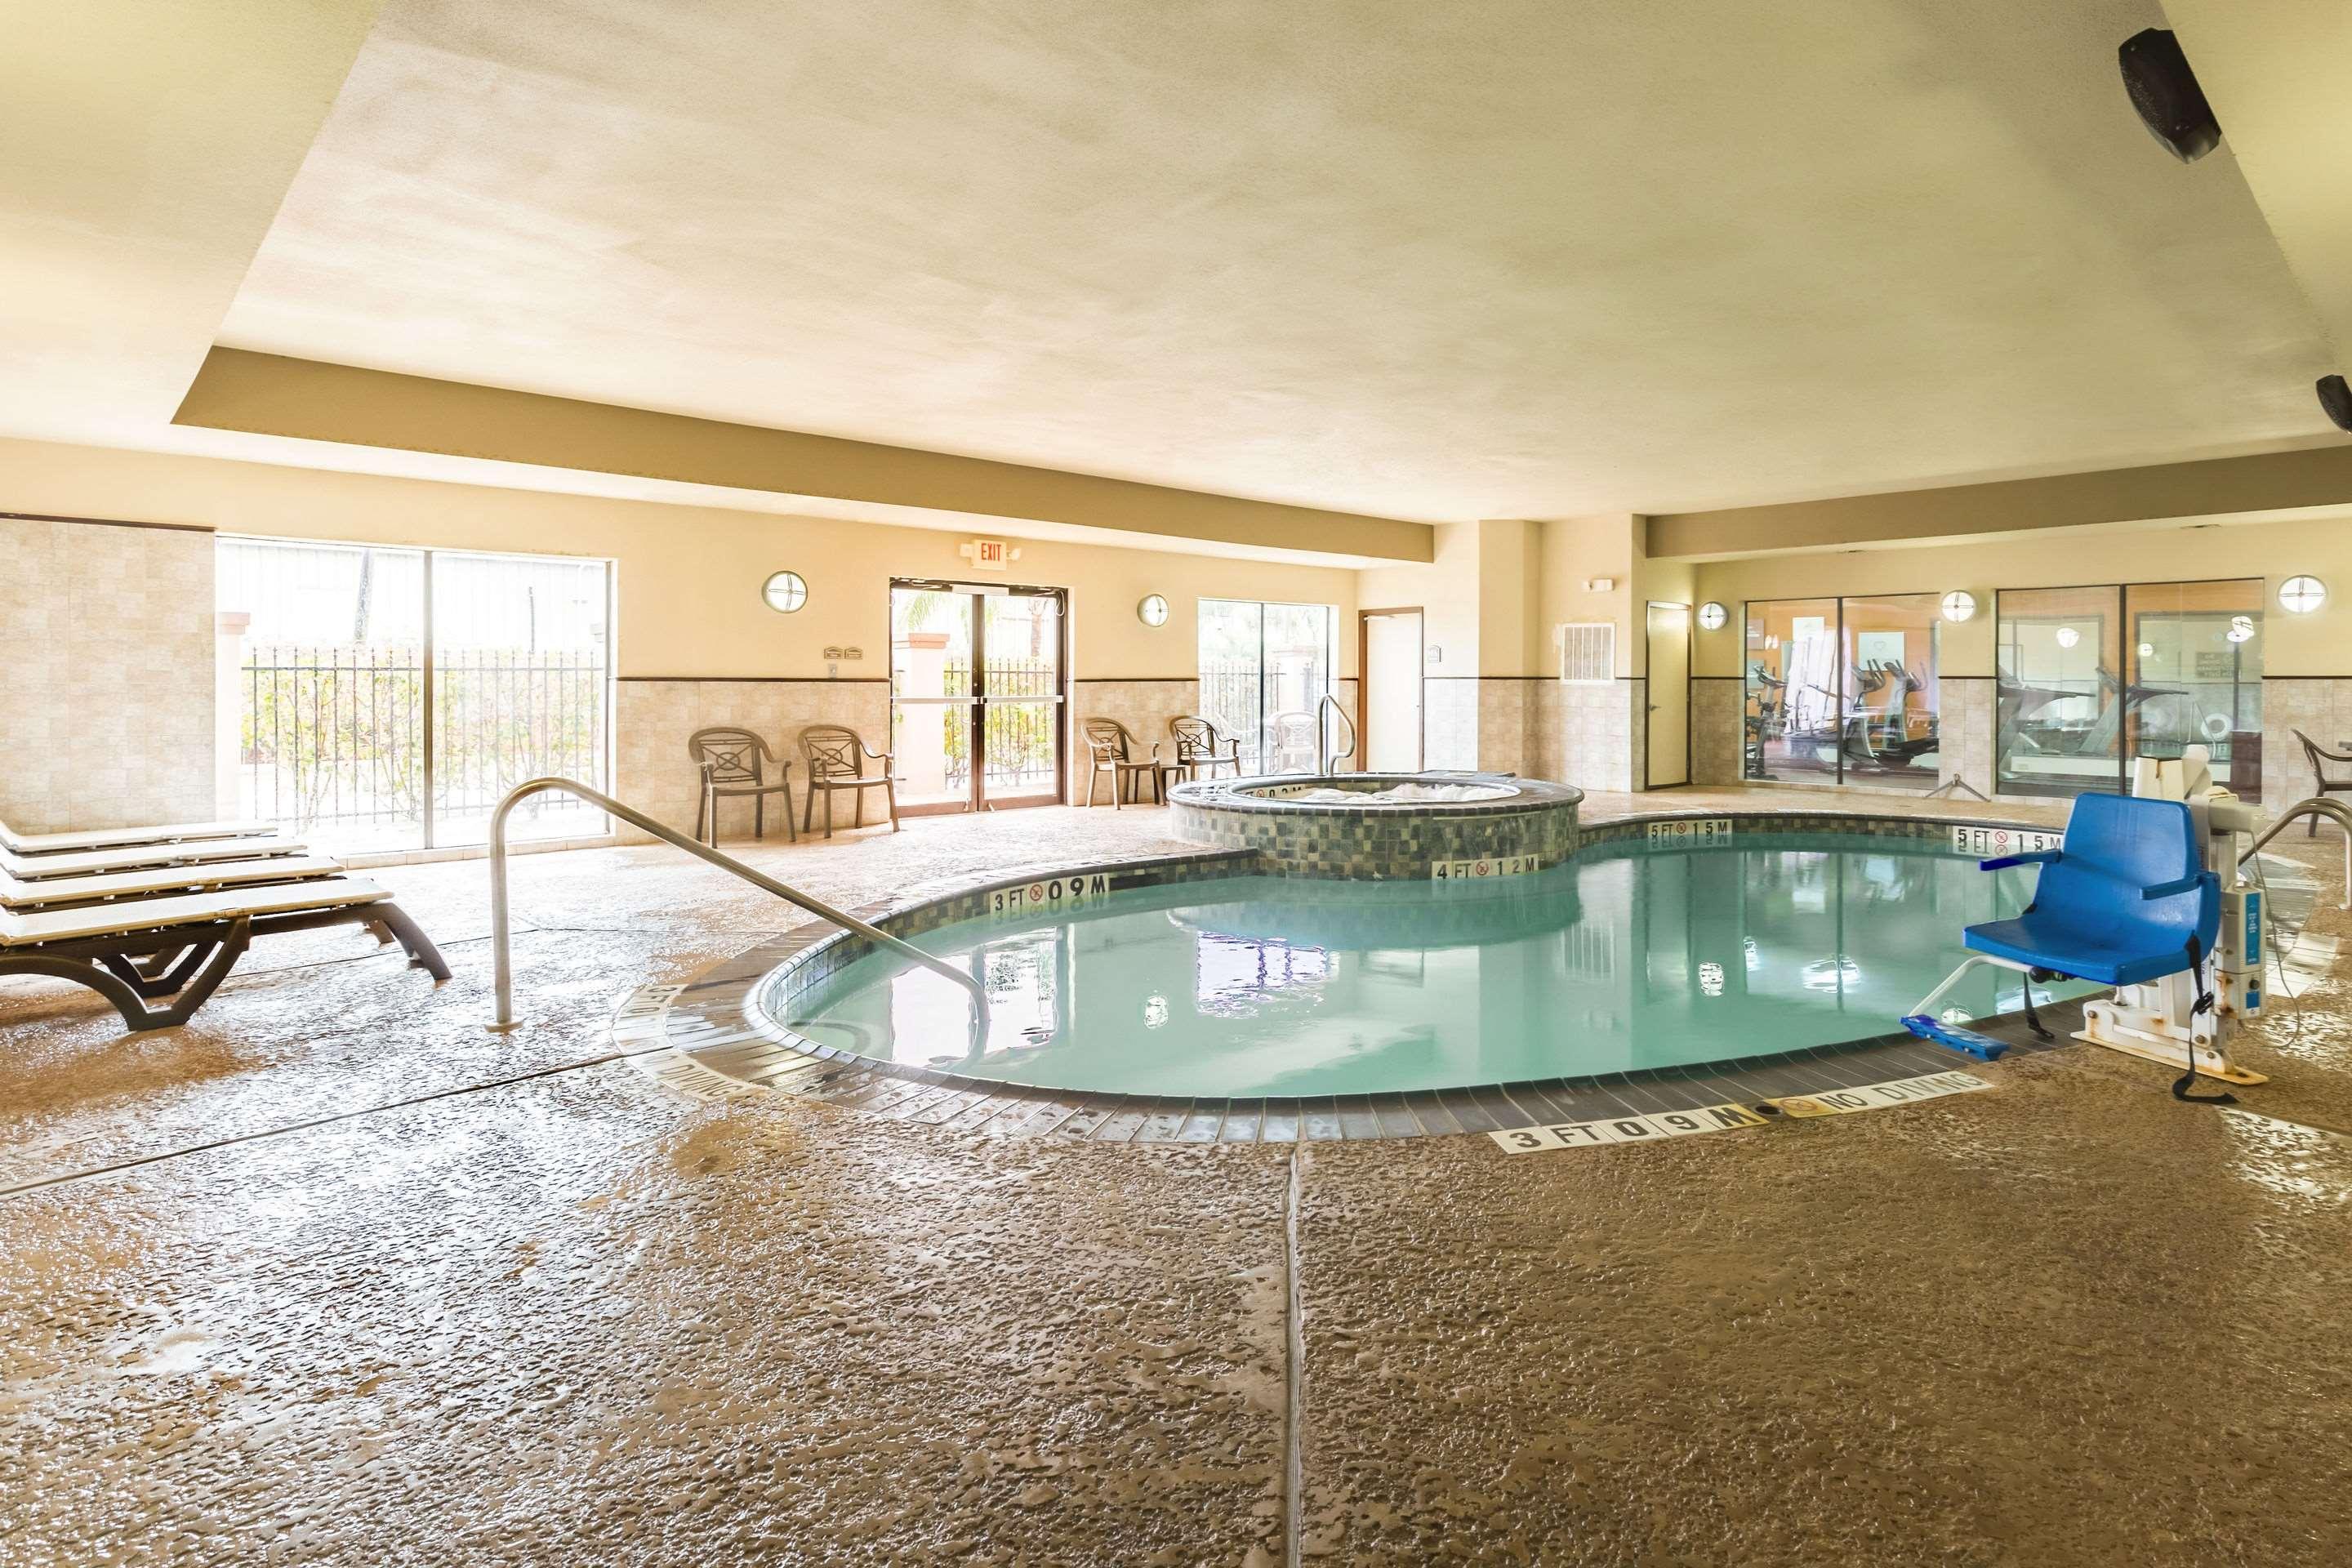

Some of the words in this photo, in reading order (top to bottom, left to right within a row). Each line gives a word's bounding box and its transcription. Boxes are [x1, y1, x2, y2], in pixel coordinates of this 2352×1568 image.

[981, 542, 1002, 562] EXIT
[1651, 825, 1659, 837] 5
[1661, 823, 1673, 837] FT
[1717, 822, 1728, 834] M
[1958, 828, 1967, 840] 5
[1973, 830, 1990, 844] FT
[2050, 837, 2061, 849] M
[1437, 863, 1448, 880] 4
[1454, 862, 1472, 879] FT
[1525, 858, 1535, 872] M
[995, 893, 1004, 911] 3
[1009, 888, 1025, 908] FT
[1091, 875, 1106, 894] M
[656, 1063, 743, 1097] DIVING
[1509, 1131, 1542, 1148] 3
[1550, 1124, 1601, 1144] FT
[1706, 1106, 1754, 1128] M
[1815, 1092, 1869, 1111] NO
[1870, 1073, 1984, 1101] DIVING
